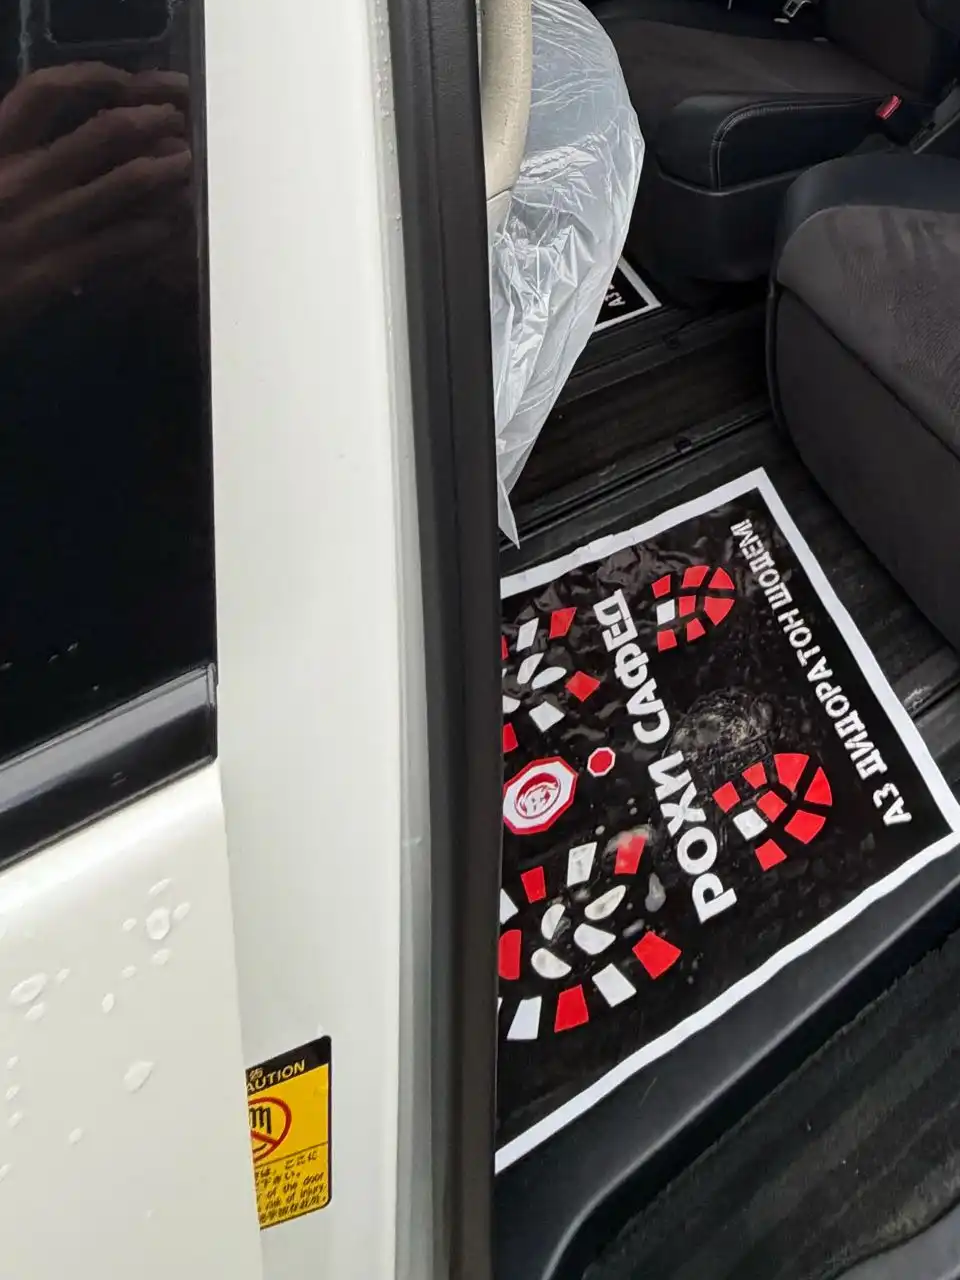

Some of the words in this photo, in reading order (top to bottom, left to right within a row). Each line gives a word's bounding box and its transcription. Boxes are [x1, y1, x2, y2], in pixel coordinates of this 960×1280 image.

[730, 519, 791, 609] ШОДЕМ!
[592, 588, 671, 745] САФЕД
[778, 608, 888, 780] ДИДОРАТОН
[648, 751, 738, 923] РОХИ
[873, 782, 912, 826] АЗ
[246, 1058, 305, 1092] AUTION
